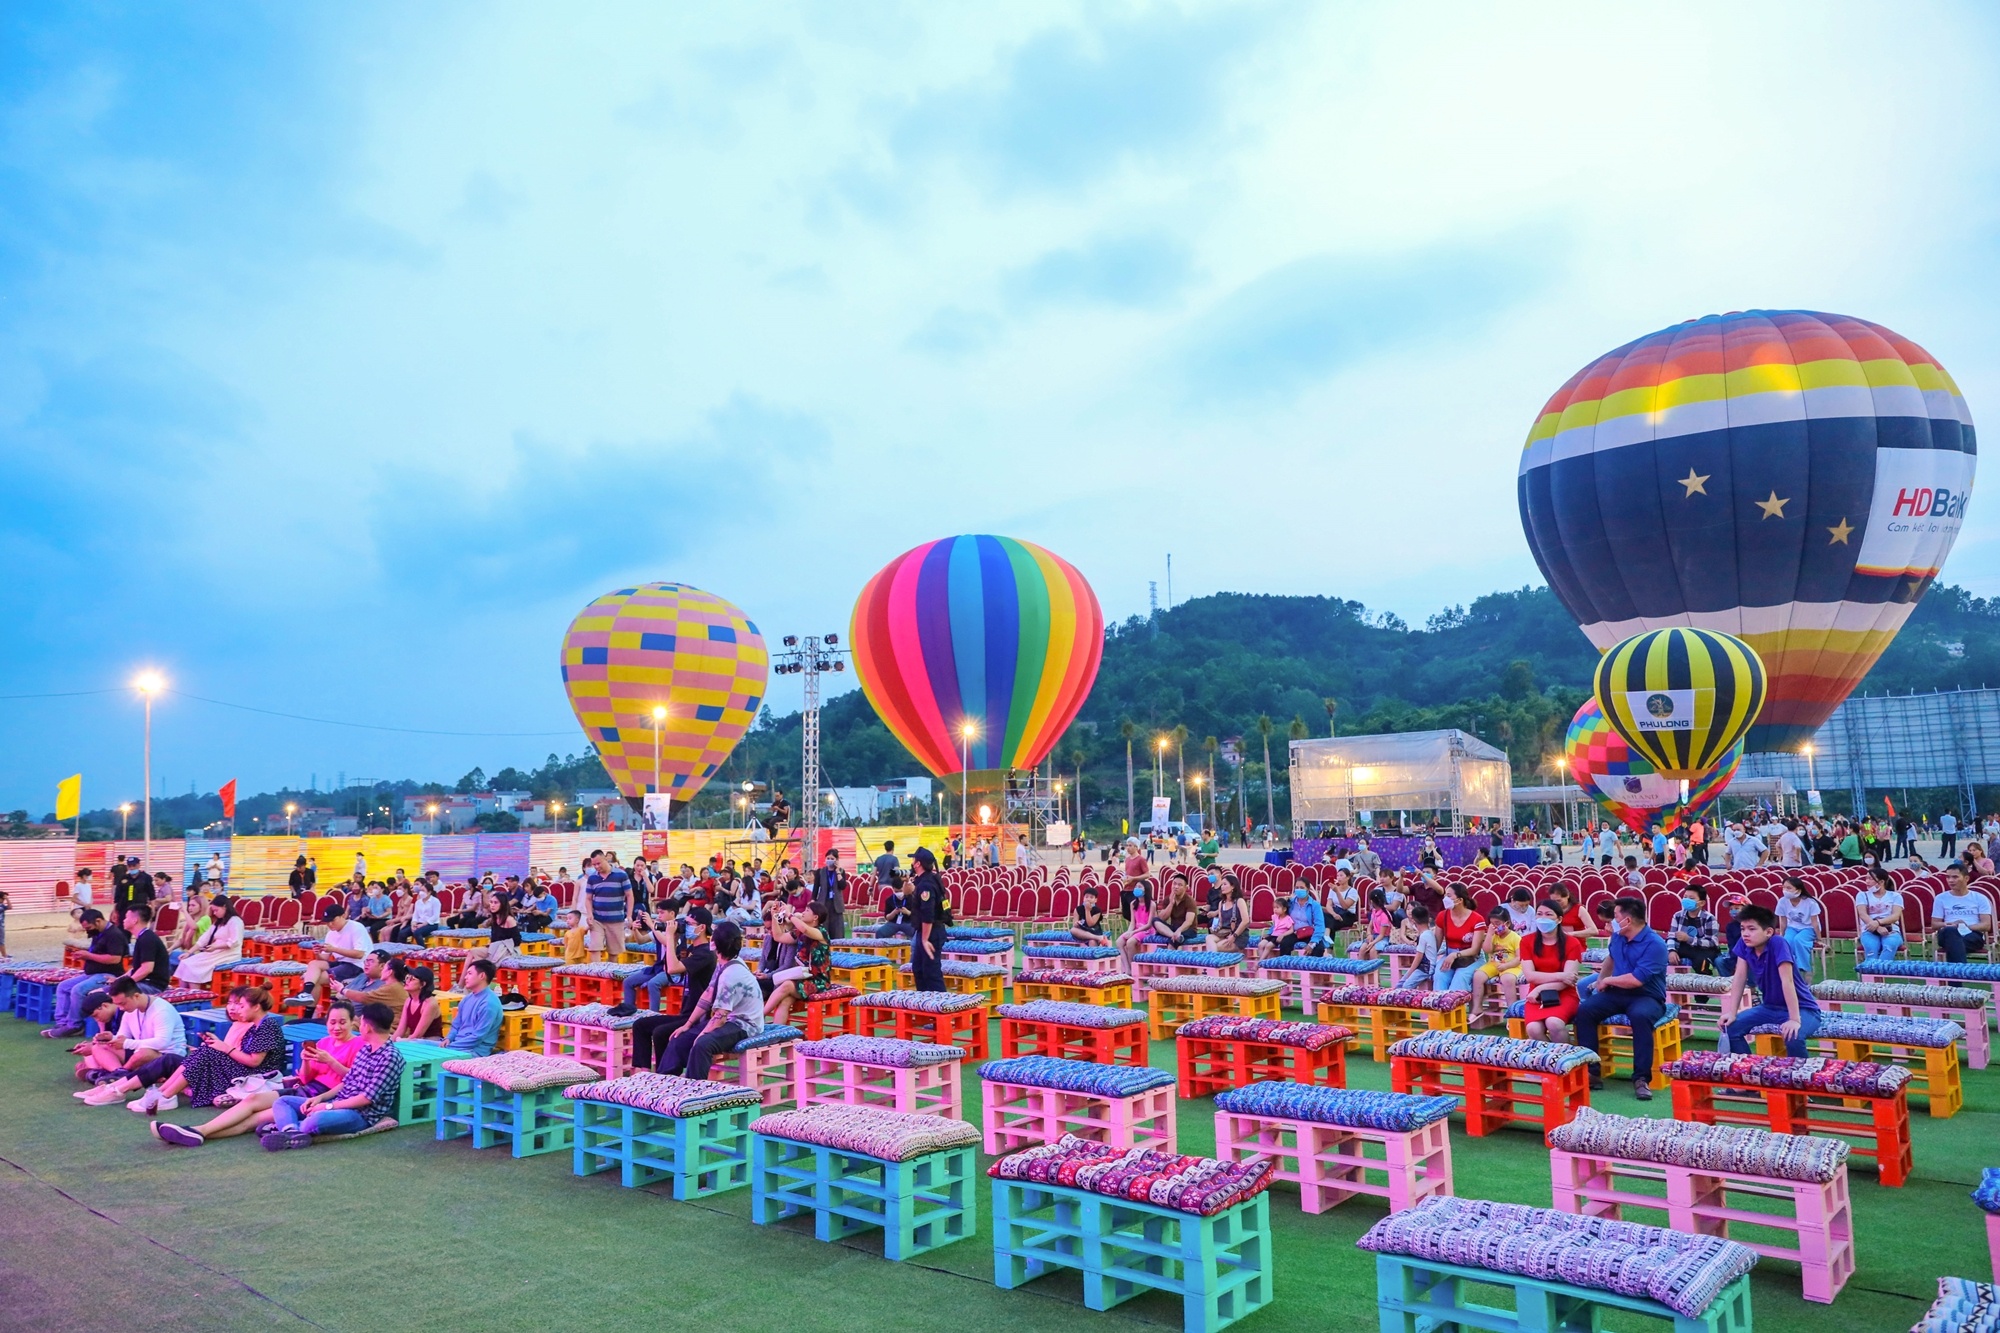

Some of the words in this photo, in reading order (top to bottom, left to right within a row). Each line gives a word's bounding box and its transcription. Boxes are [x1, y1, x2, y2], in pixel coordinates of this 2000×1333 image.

[1892, 488, 1968, 519] HDBak
[1887, 522, 1909, 532] Cam
[1639, 720, 1689, 728] PHULONG
